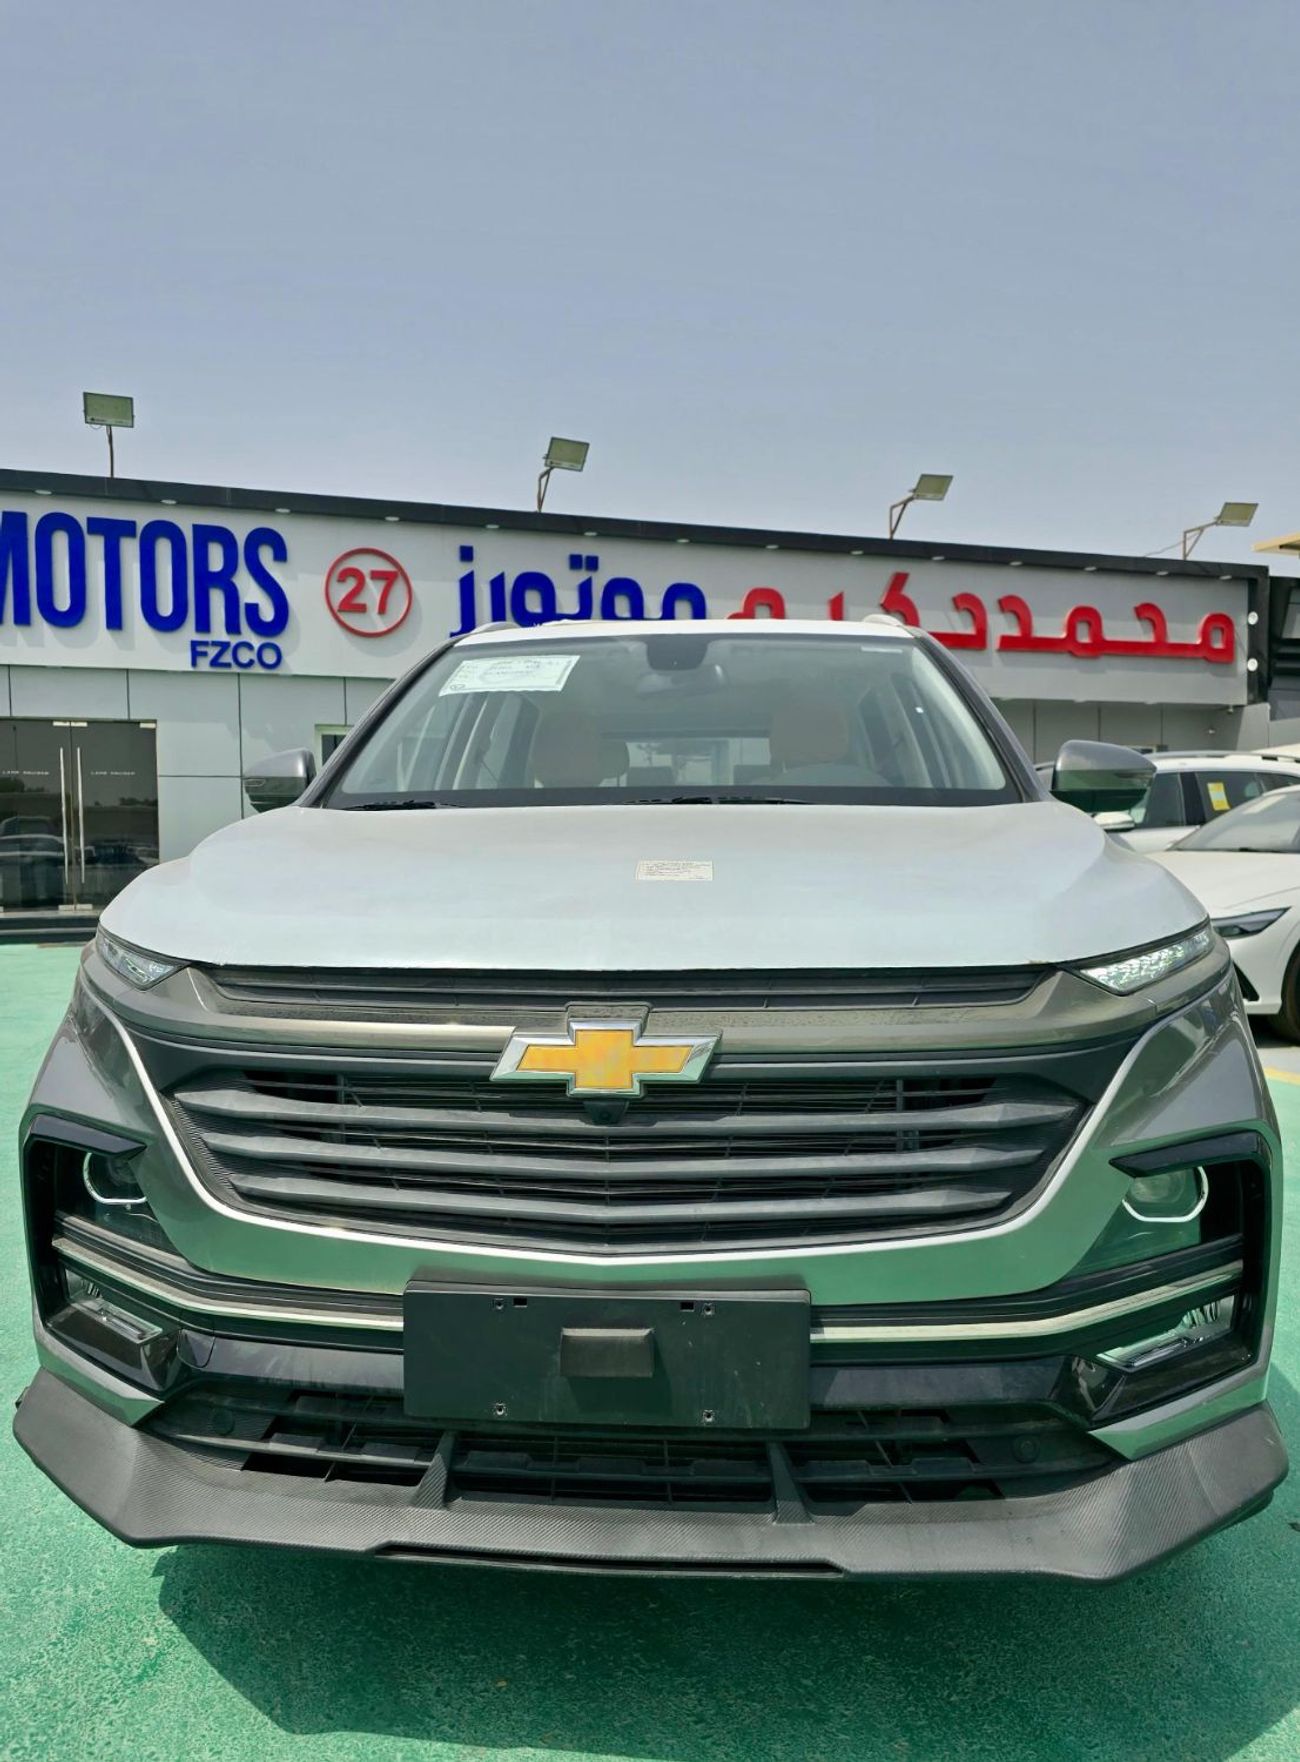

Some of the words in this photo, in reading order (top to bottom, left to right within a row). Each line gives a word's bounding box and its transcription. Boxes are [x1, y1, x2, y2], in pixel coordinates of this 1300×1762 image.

[336, 566, 400, 615] 27
[996, 594, 1236, 664] محمد
[190, 639, 283, 670] FZCO
